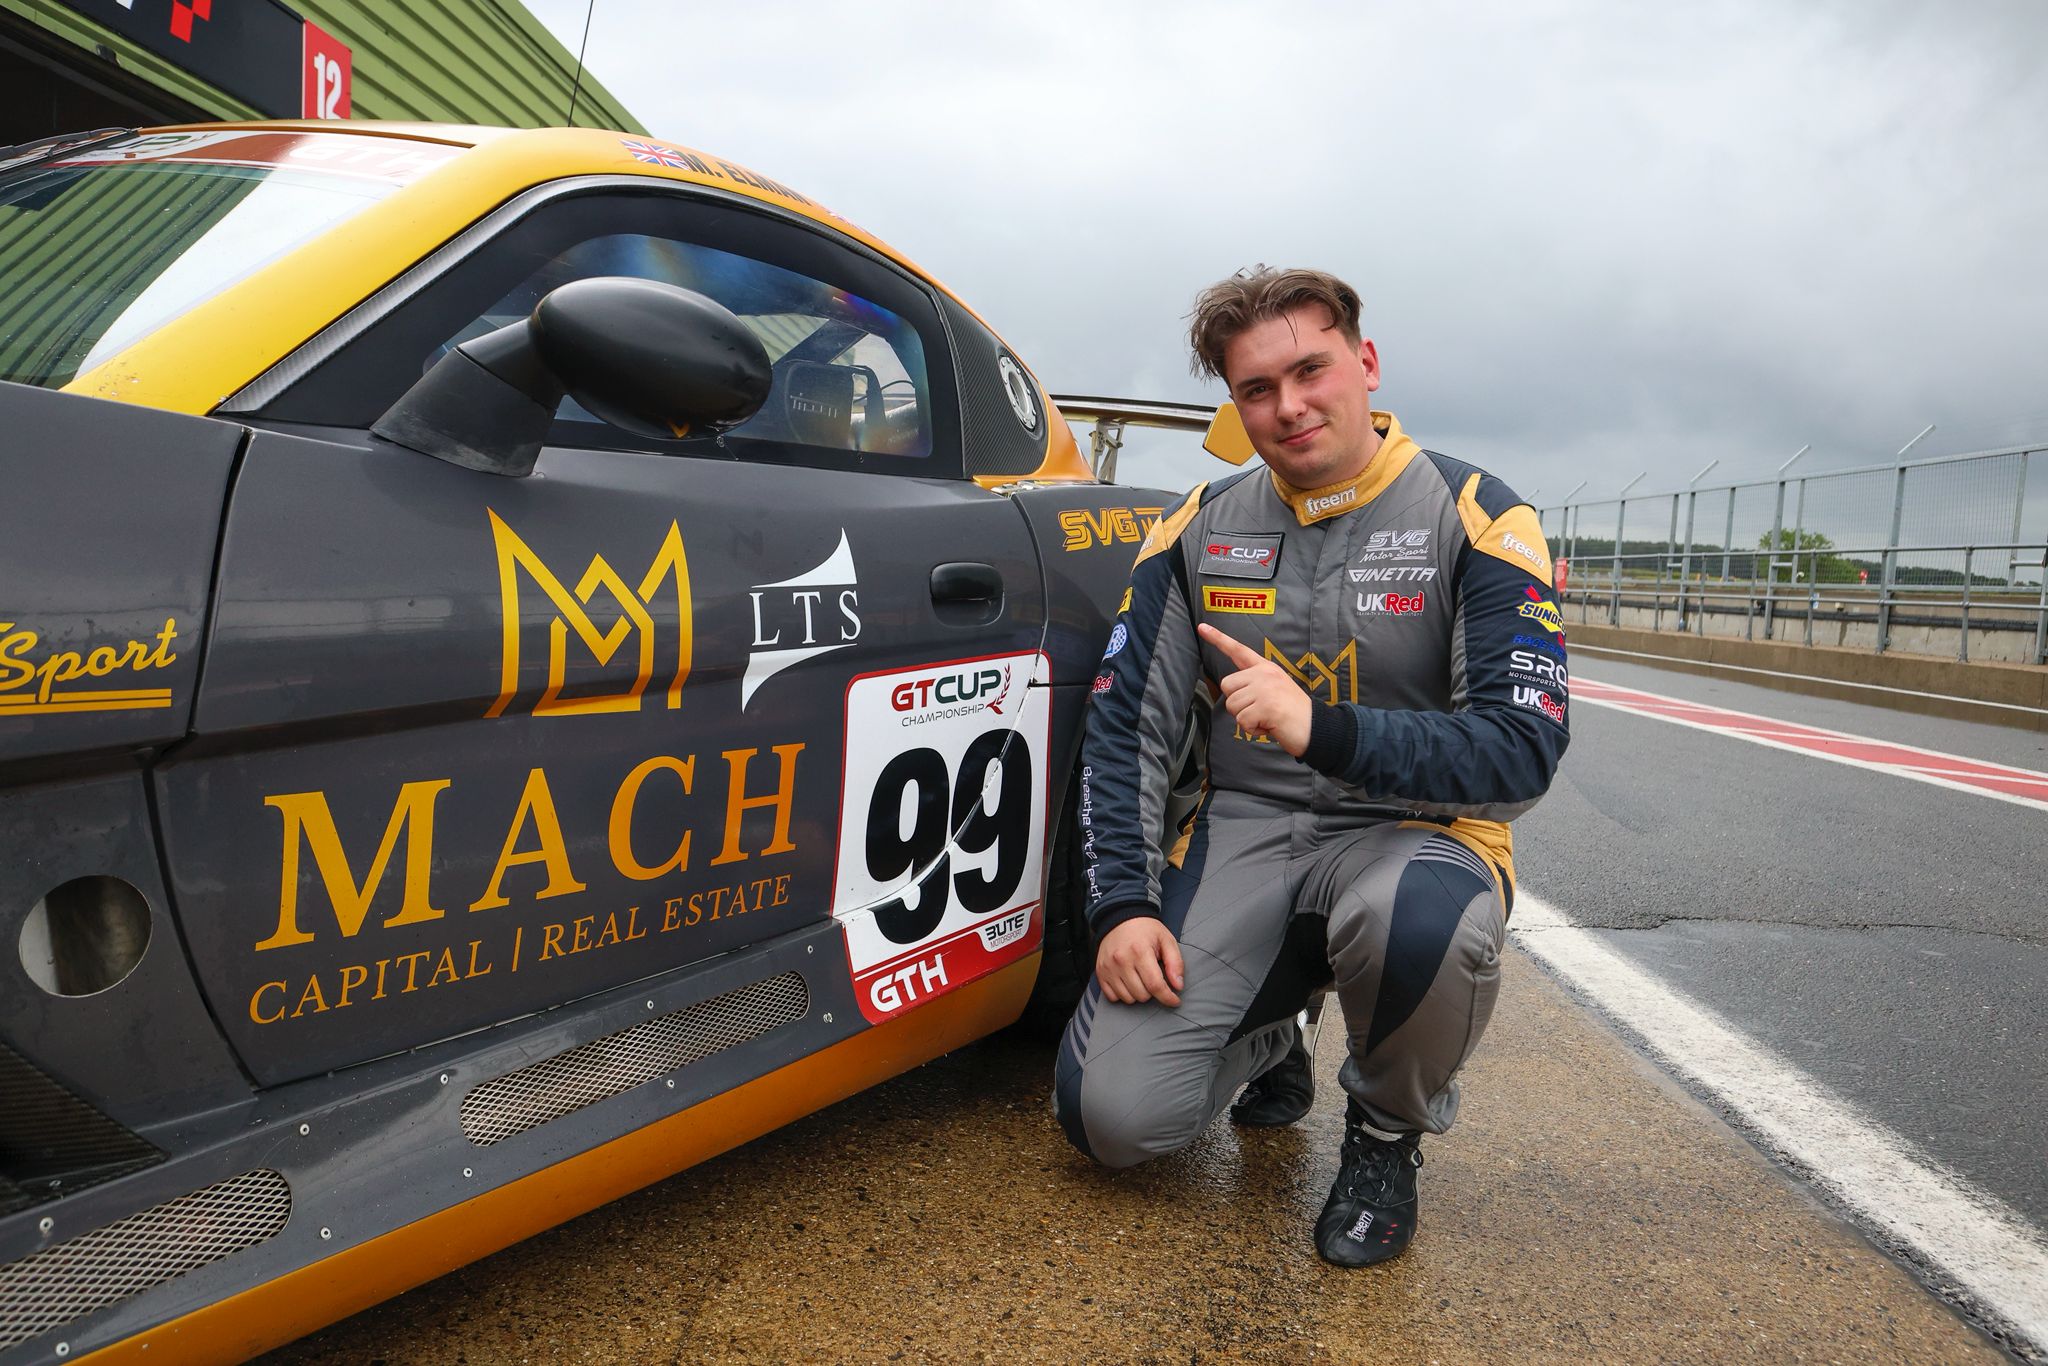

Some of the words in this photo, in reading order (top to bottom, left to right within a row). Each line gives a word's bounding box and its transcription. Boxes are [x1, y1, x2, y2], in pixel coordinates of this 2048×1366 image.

[313, 52, 342, 119] 12
[1058, 506, 1141, 552] SVG
[1396, 545, 1429, 558] Sport
[1348, 567, 1437, 582] GINETTA
[1210, 592, 1267, 609] PIRELLI
[0, 618, 178, 704] Sport
[1508, 671, 1556, 687] MOTORSPORTS
[901, 703, 985, 727] CHAMPIONSHIP
[254, 742, 806, 952] MACH
[865, 728, 1032, 945] 99
[249, 940, 493, 1025] CAPITAL
[538, 906, 648, 964] REAL
[660, 874, 792, 934] ESTATE
[990, 928, 1023, 949] MOTORSPORT
[870, 953, 949, 1013] GTH
